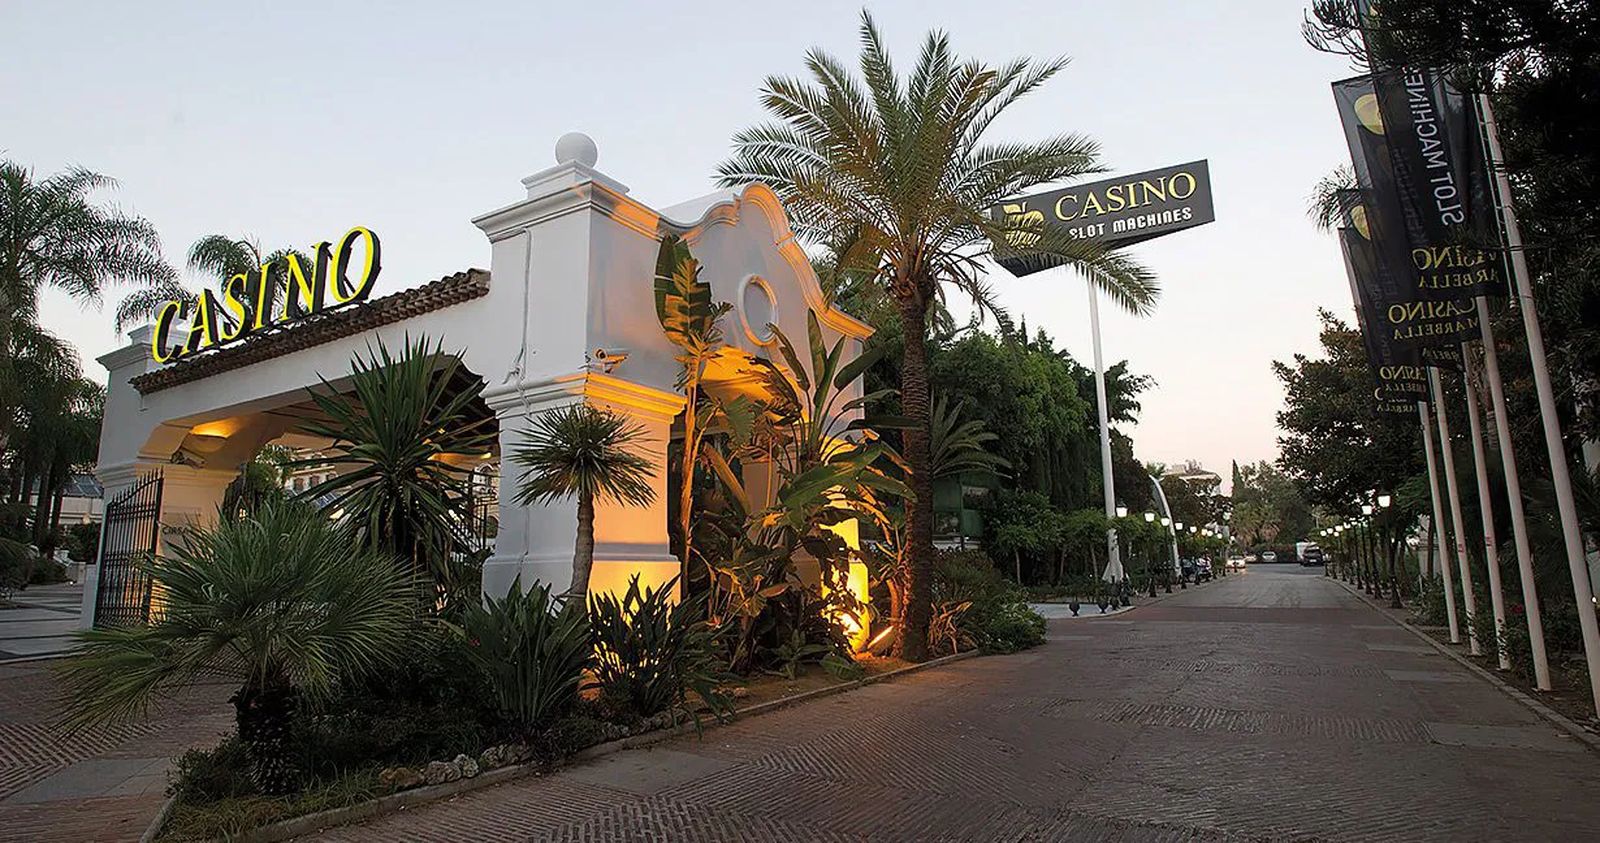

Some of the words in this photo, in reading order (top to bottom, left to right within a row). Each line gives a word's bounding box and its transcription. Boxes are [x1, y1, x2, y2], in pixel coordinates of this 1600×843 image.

[1054, 171, 1197, 222] CASINO
[1068, 223, 1105, 240] SLOT
[1112, 206, 1193, 234] MACHINES
[152, 225, 381, 364] CASINO
